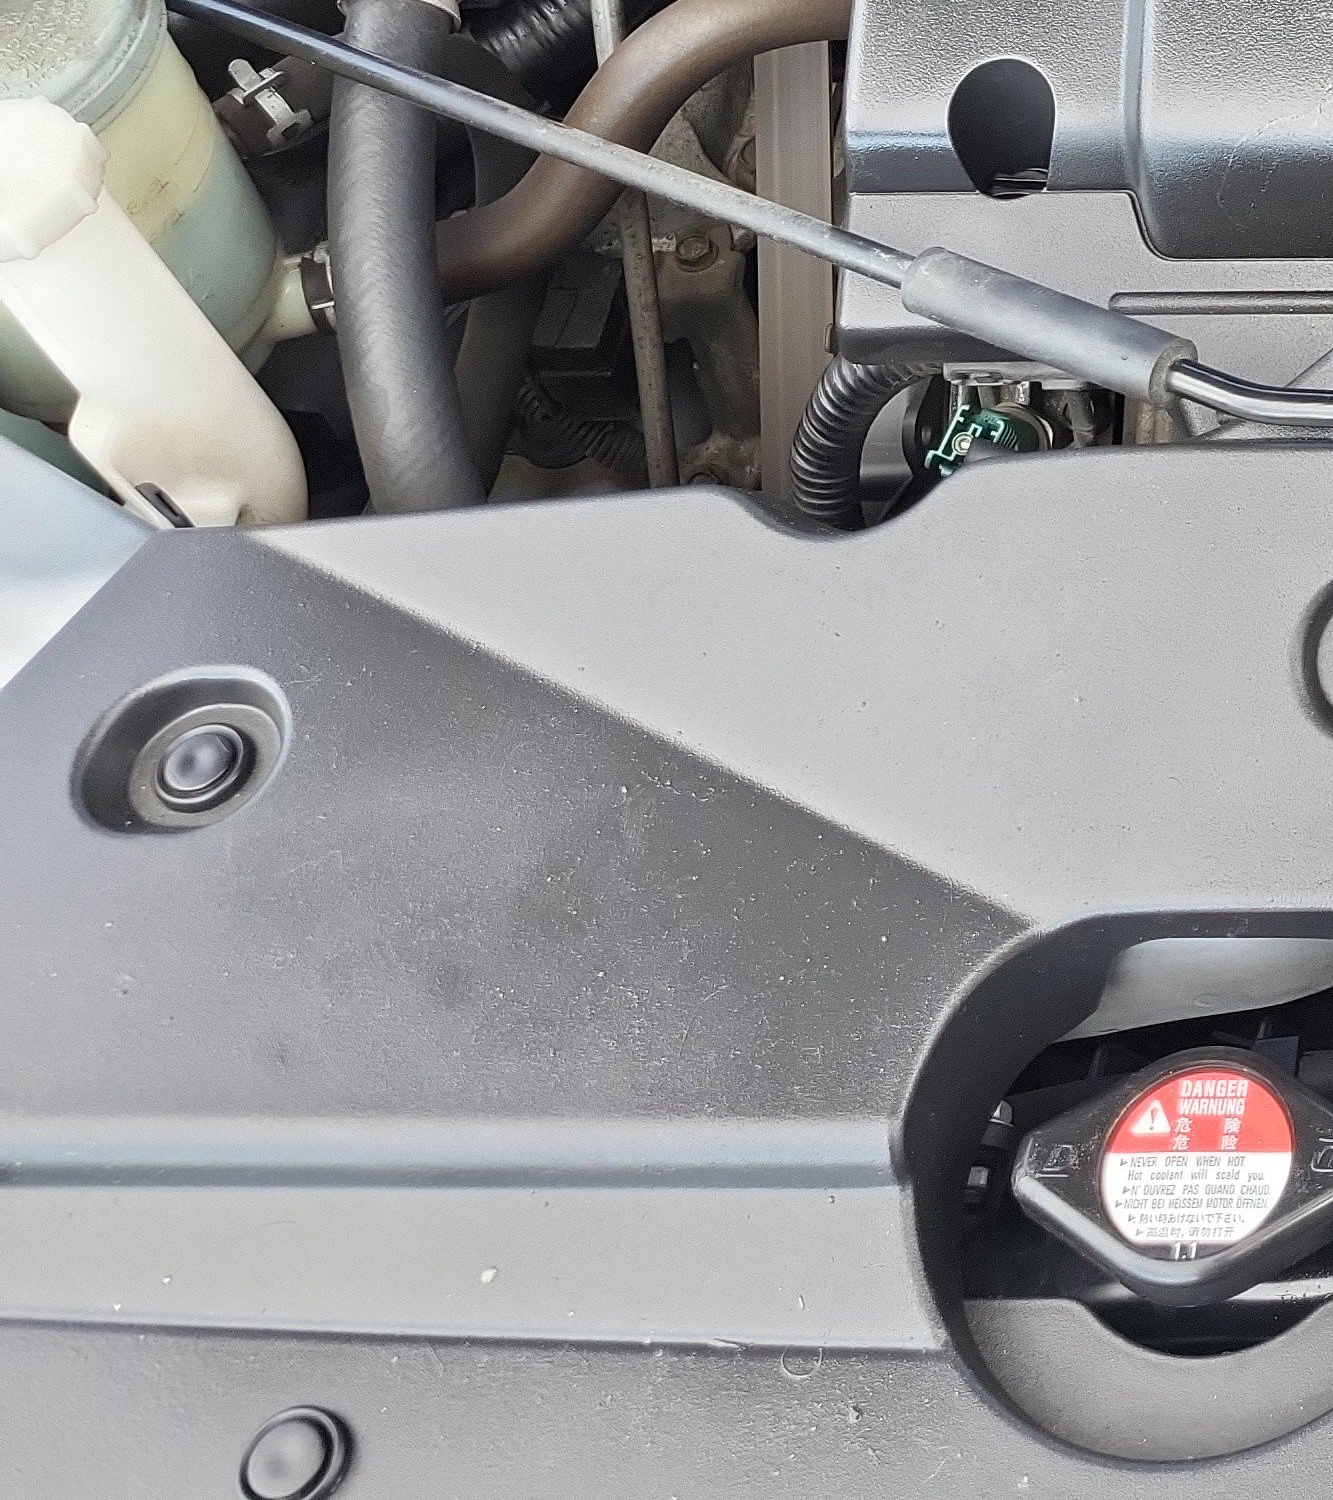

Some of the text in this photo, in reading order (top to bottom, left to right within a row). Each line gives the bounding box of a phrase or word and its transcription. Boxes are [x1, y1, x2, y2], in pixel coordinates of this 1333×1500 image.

[1180, 1079, 1249, 1097] DANGER
[1178, 1098, 1246, 1115] WARNUNG
[1130, 1156, 1158, 1168] NEVER
[1164, 1155, 1189, 1167] OPEN
[1195, 1155, 1222, 1167] WHEN
[1127, 1169, 1143, 1181] Hot
[1150, 1169, 1184, 1180] coolant
[1191, 1168, 1208, 1180] will
[1215, 1169, 1241, 1180] scald
[1143, 1184, 1177, 1196] OUVREZ
[1181, 1184, 1200, 1195] PAS
[1204, 1184, 1236, 1195] QUAND
[1123, 1198, 1149, 1210] NICHT
[1151, 1198, 1166, 1210] BEI
[1173, 1241, 1199, 1260] 1.1
